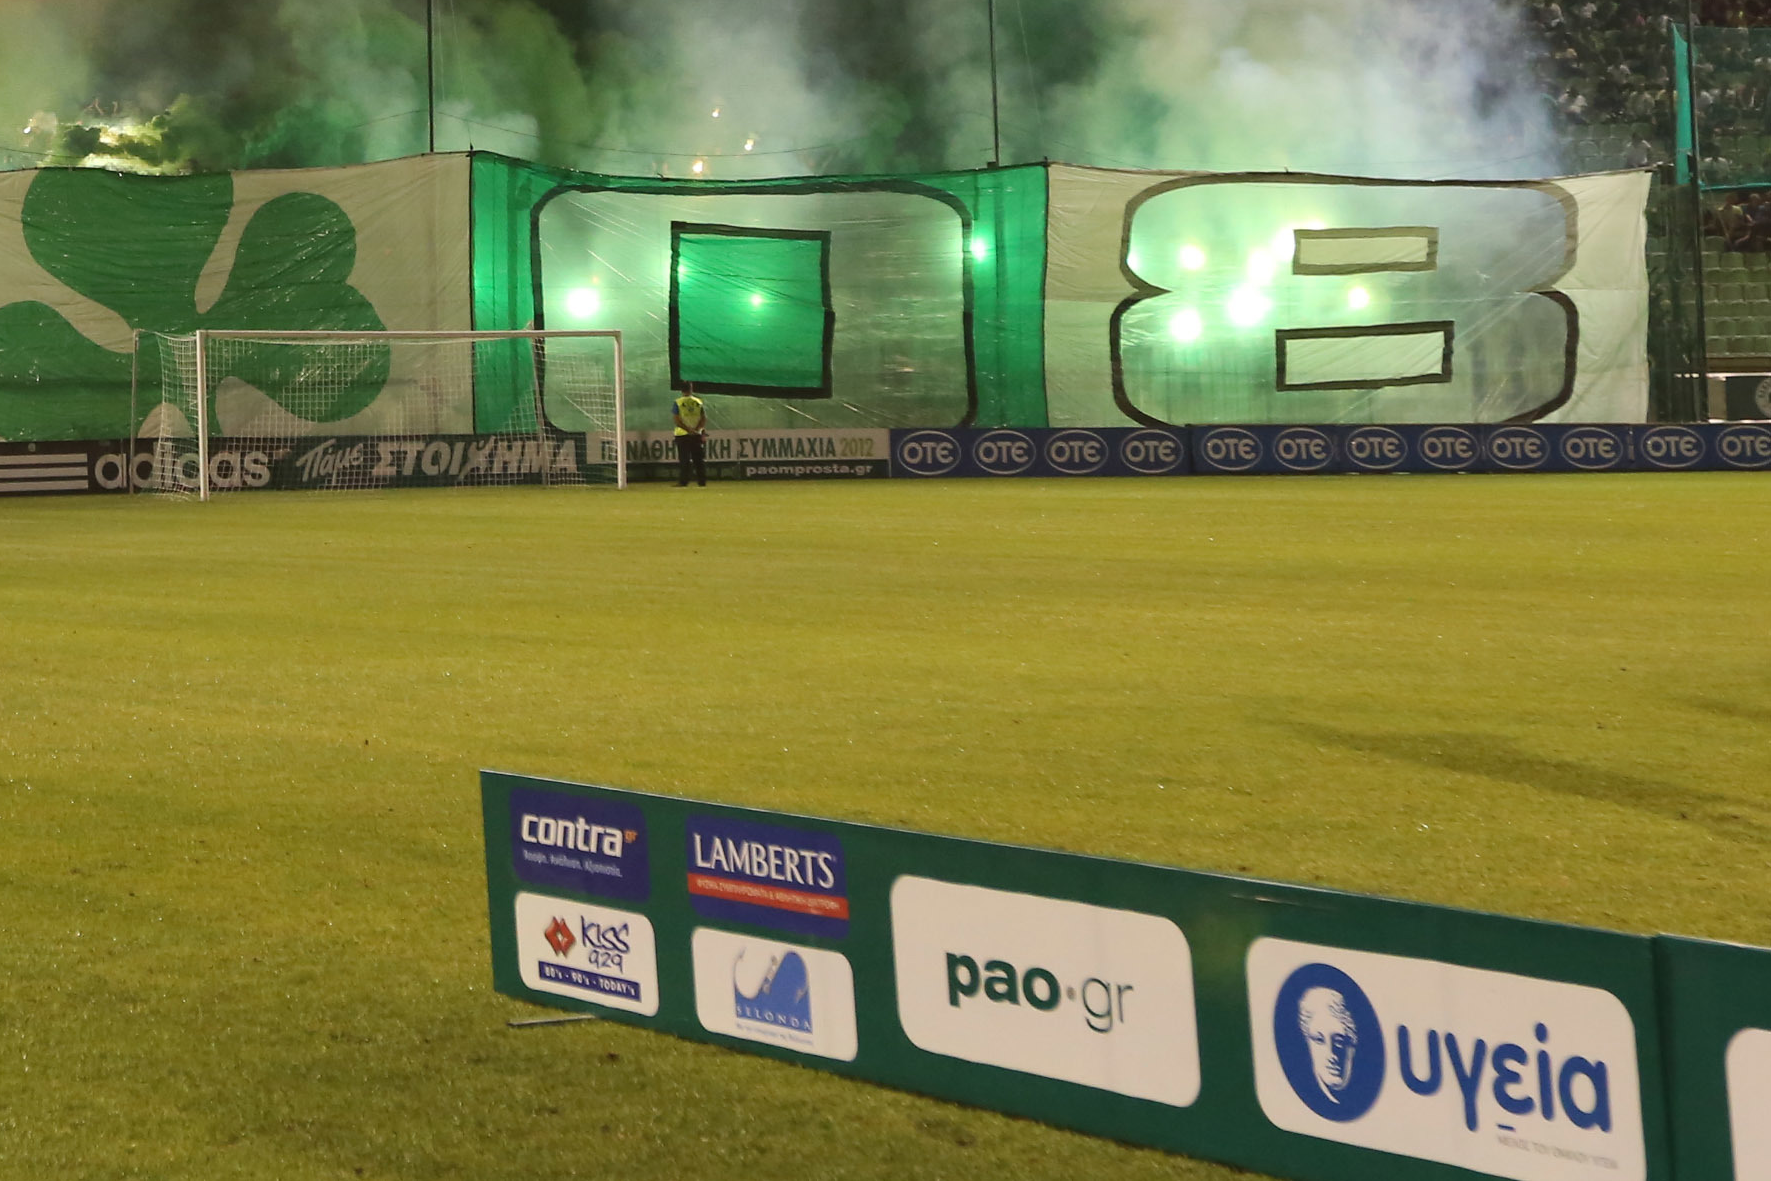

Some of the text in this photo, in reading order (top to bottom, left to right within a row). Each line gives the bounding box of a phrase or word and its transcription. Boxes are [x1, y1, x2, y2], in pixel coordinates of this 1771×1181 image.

[739, 437, 836, 458] ΣΥΜΜΑΧΙΑ
[840, 437, 874, 457] 2012
[746, 464, 873, 476] paomprosta.gr
[521, 814, 623, 858] contra
[694, 833, 834, 889] LAMBERTS
[588, 949, 623, 974] 929
